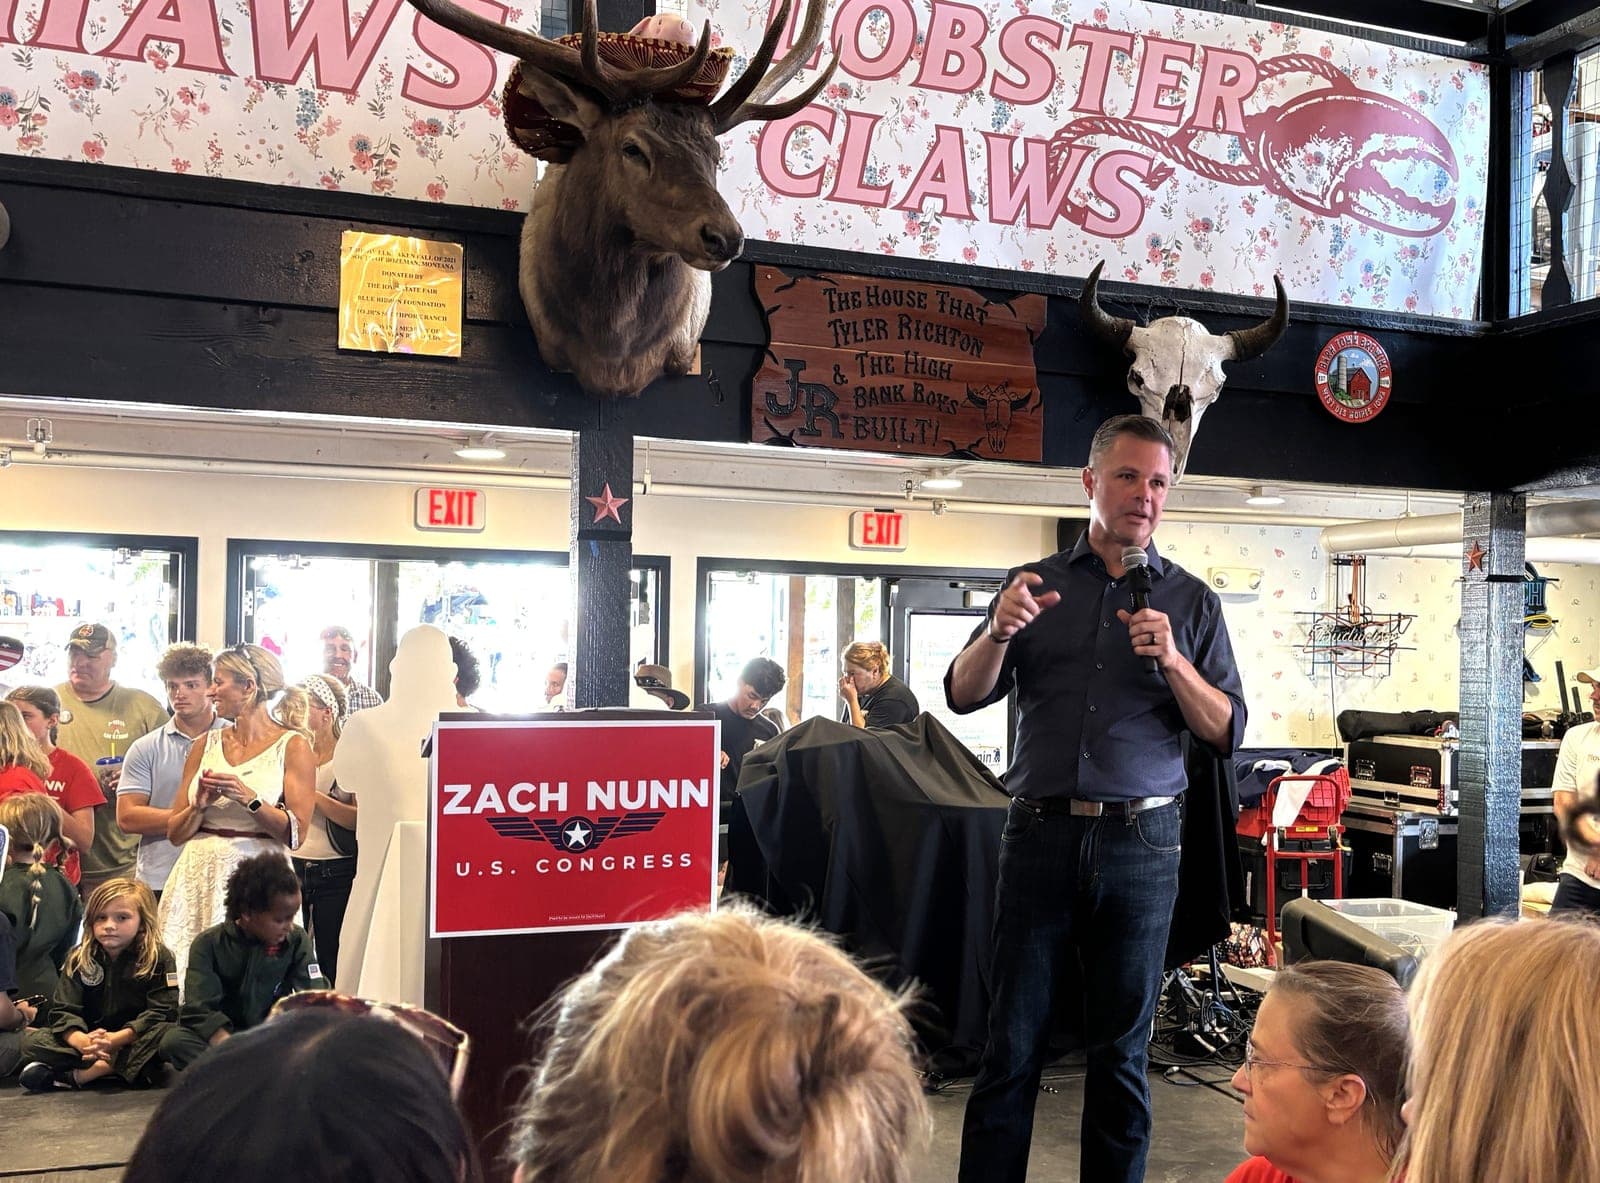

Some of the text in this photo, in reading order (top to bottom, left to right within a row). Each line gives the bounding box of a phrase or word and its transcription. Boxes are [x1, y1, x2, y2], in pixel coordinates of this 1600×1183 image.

[764, 0, 1258, 135] LOBSTER
[755, 104, 1156, 239] CLAWS
[381, 270, 414, 279] DONATED
[421, 261, 455, 270] MONTANA
[403, 299, 446, 309] FOUNDATION
[822, 285, 989, 327] THE HOUSE THAT
[827, 318, 889, 348] TYLER
[832, 350, 954, 386] & THE HIGH
[853, 381, 959, 416] BANK BOYS
[852, 415, 941, 447] BUILT!
[429, 489, 477, 526] EXIT
[863, 512, 903, 545] EXIT
[443, 778, 709, 815] ZACH NUNN
[456, 853, 692, 877] U.S. CONGRESS
